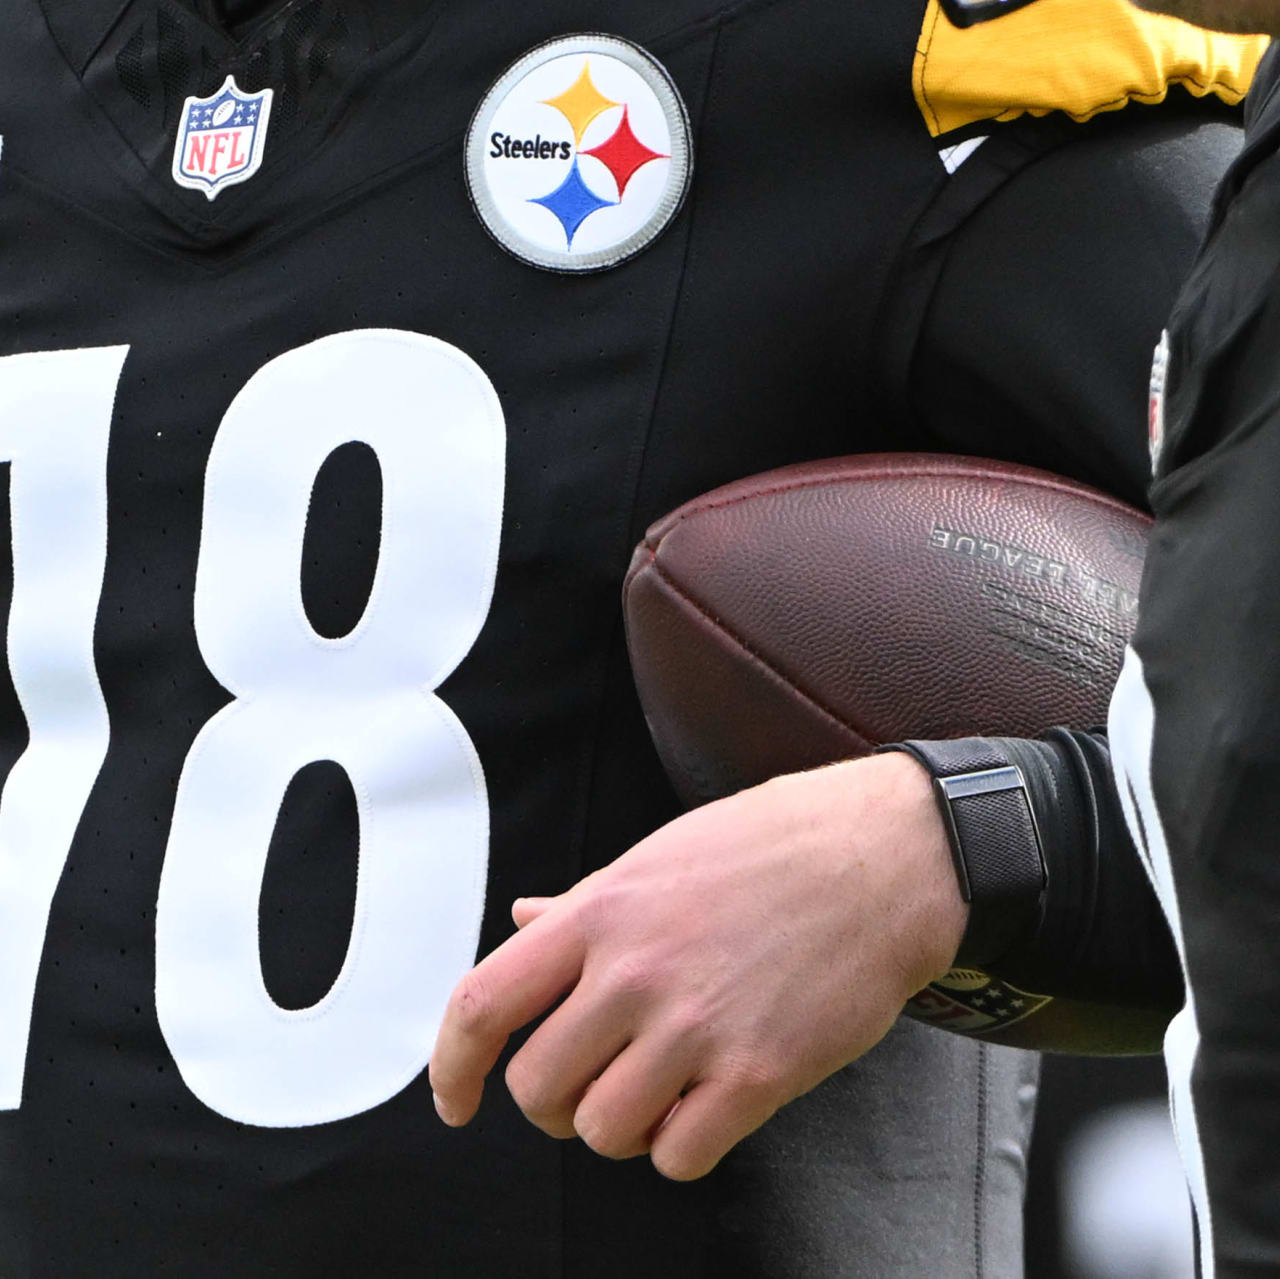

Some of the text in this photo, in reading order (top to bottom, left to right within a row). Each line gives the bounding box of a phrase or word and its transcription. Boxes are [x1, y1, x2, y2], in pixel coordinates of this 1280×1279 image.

[186, 131, 245, 176] NFL
[489, 131, 572, 160] Steelers
[930, 527, 1066, 579] LEAGUE
